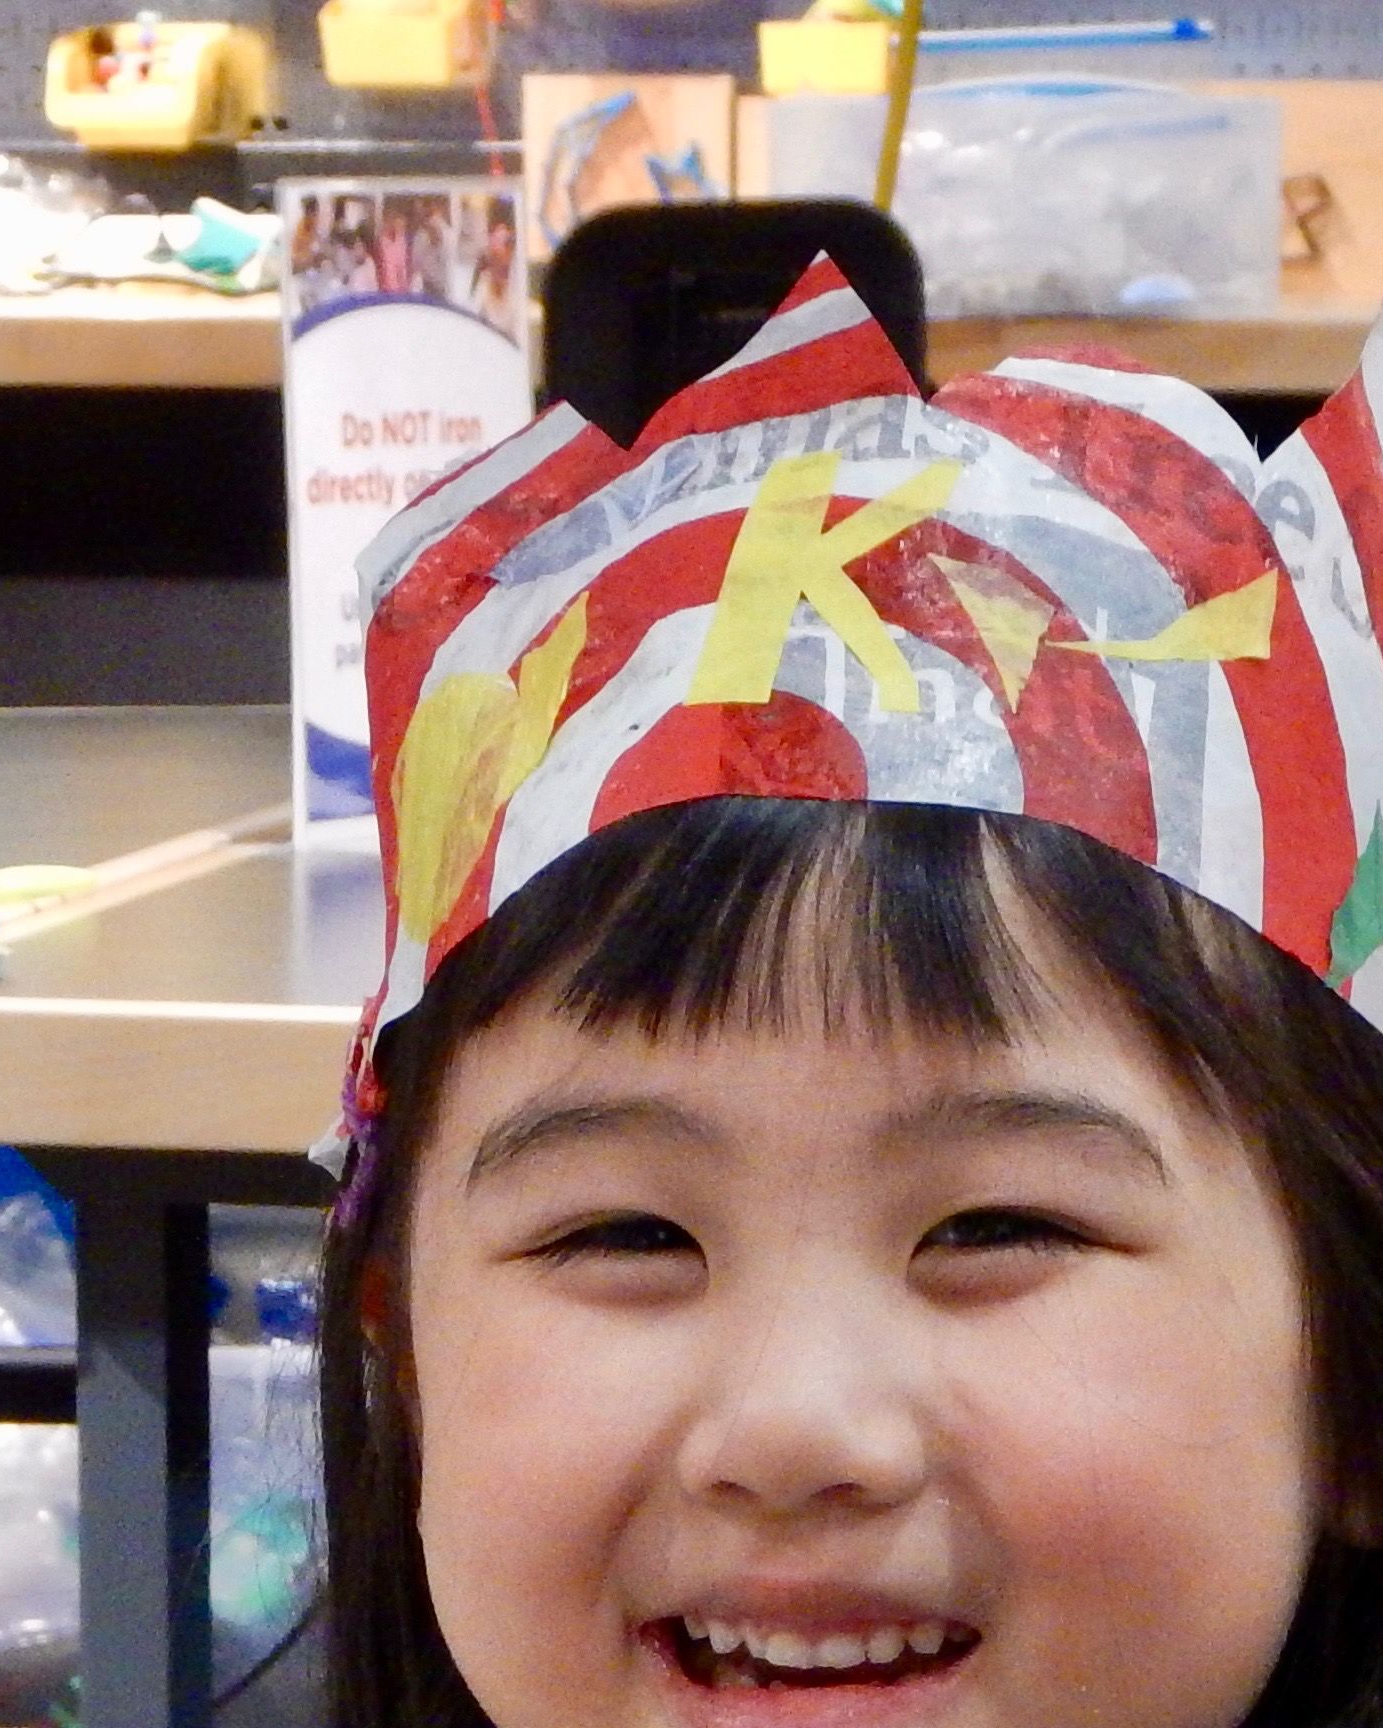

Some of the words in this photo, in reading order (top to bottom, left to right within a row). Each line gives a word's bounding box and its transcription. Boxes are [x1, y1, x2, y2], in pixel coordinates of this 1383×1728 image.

[341, 413, 374, 447] Do
[381, 411, 431, 445] NOT
[440, 414, 484, 444] iron
[306, 466, 396, 506] directly
